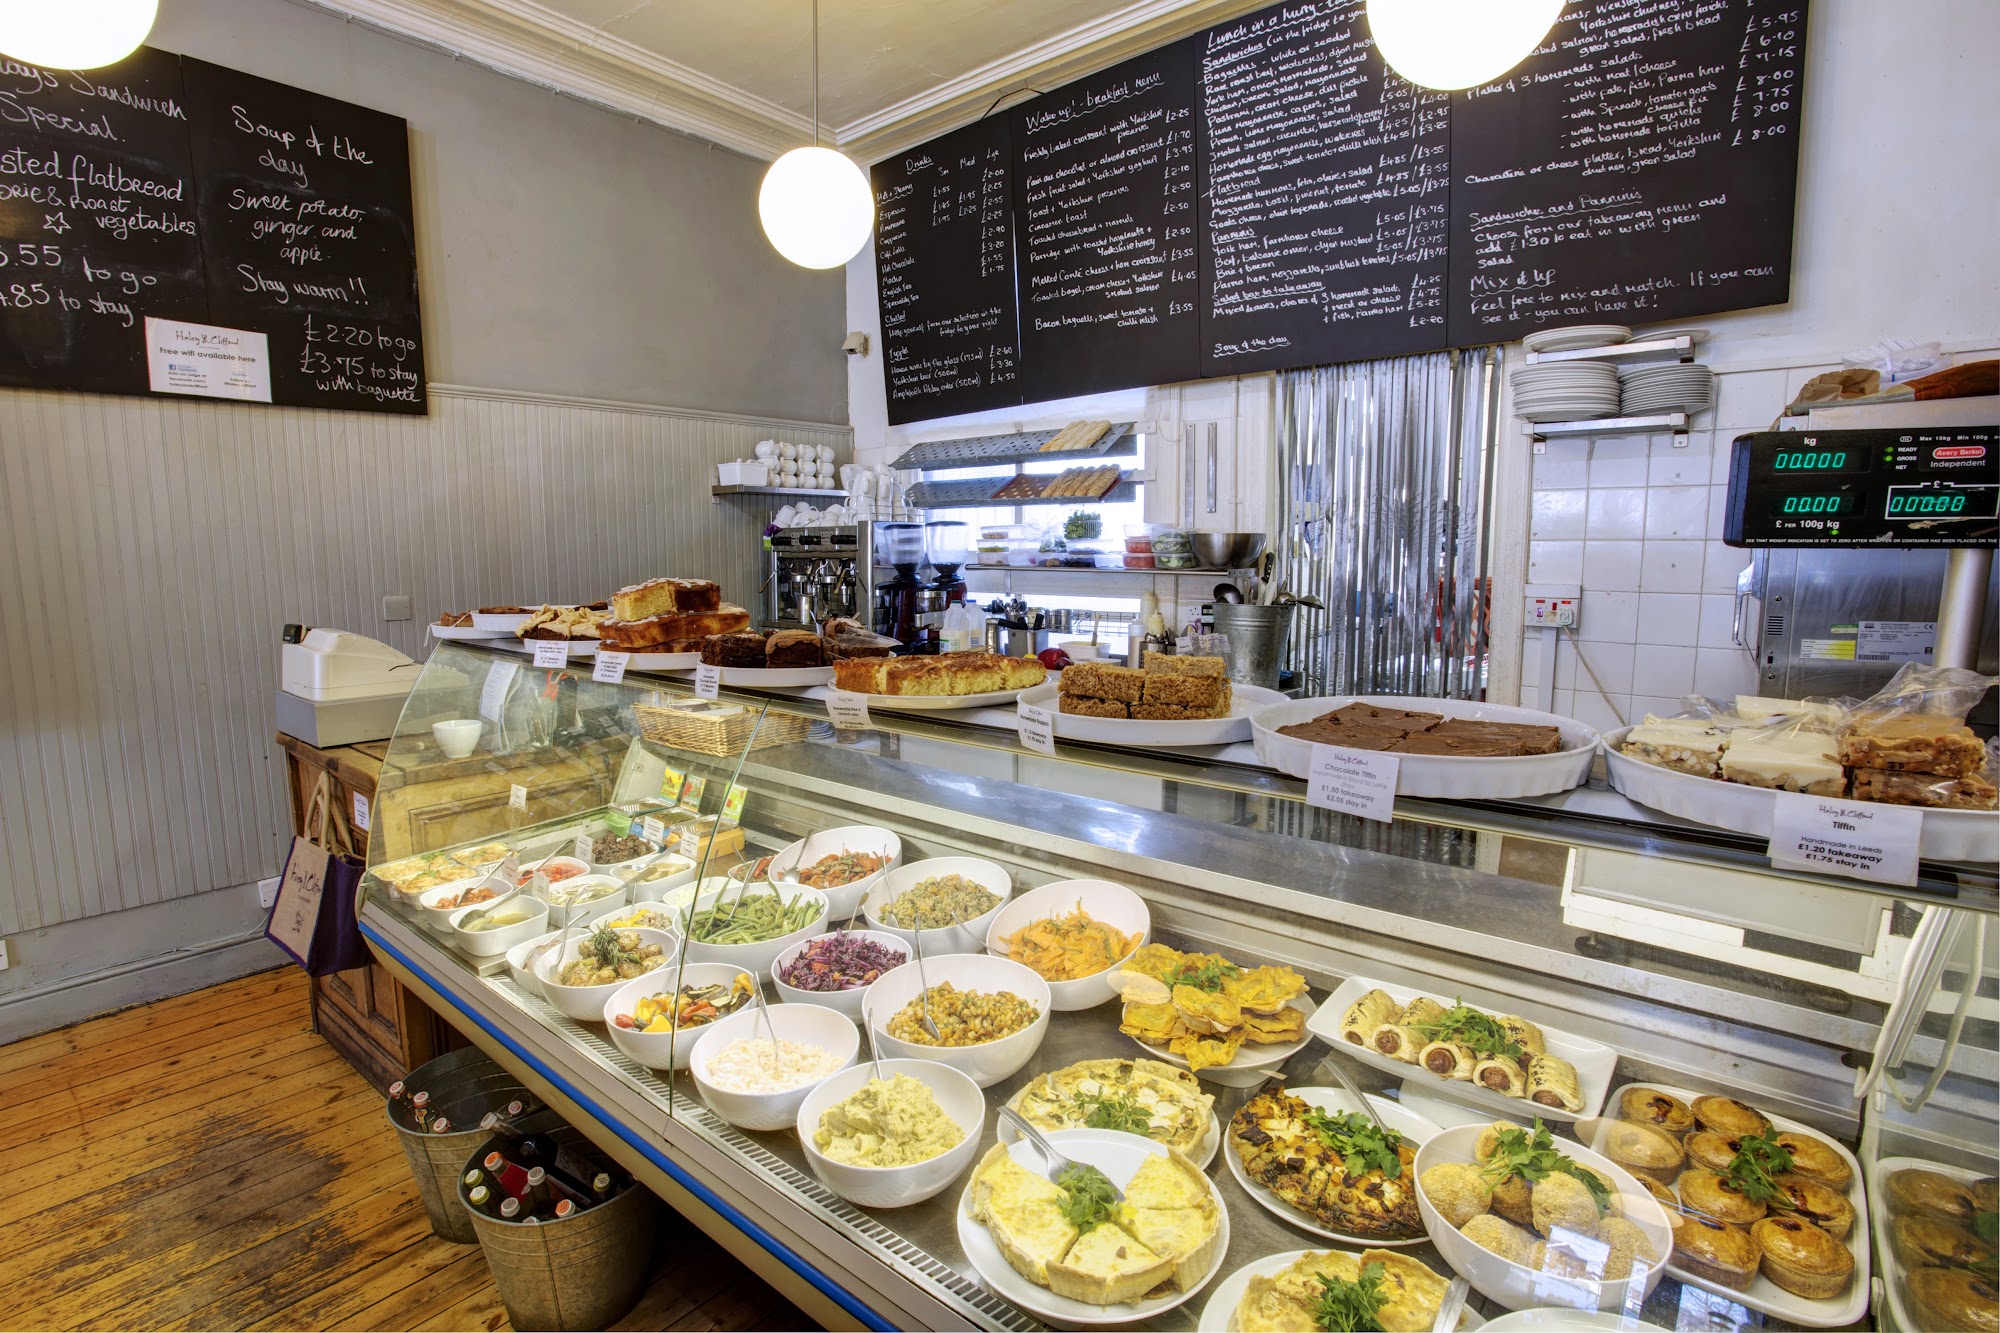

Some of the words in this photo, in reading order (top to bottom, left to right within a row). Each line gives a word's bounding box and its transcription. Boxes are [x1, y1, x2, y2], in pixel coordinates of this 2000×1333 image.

[1208, 24, 1247, 48] Lunch
[1252, 18, 1265, 32] in
[1269, 16, 1278, 26] a
[1282, 4, 1317, 22] hurry
[1202, 42, 1263, 69] Sandwiches
[1285, 29, 1300, 41] the
[1302, 18, 1330, 37] fridge
[1506, 79, 1516, 93] of
[1521, 75, 1531, 87] 3
[1535, 62, 1594, 83] homemade
[1599, 50, 1642, 68] salads
[70, 69, 187, 121] Sandwich
[1026, 111, 1057, 130] Wake
[1087, 82, 1129, 106] breakfast
[1166, 108, 1189, 124] £2.25
[231, 105, 297, 150] Soup
[306, 125, 325, 156] of
[333, 136, 374, 165] the
[1166, 130, 1191, 146] £1.70
[906, 155, 933, 172] Drinks
[1166, 147, 1193, 161] £3.95
[67, 154, 183, 202] flatbread
[259, 149, 308, 189] day
[47, 185, 66, 206] &
[228, 189, 293, 211] Sweet
[1209, 178, 1261, 198] Flatbread
[1469, 206, 1544, 227] Sandwiches
[1548, 202, 1574, 213] and
[1579, 187, 1642, 208] Panninis
[1474, 231, 1520, 242] Choose
[1524, 225, 1553, 239] from
[1557, 220, 1583, 231] our
[1588, 211, 1653, 227] takeaway
[1698, 194, 1727, 207] and
[251, 219, 315, 244] ginger
[321, 226, 358, 240] and
[1475, 241, 1503, 255] add
[1554, 233, 1565, 244] to
[1569, 230, 1593, 240] eat
[1598, 227, 1612, 236] in
[1619, 219, 1657, 234] with
[1662, 214, 1700, 233] green
[1478, 255, 1514, 269] salad
[83, 256, 111, 282] to
[121, 270, 157, 295] go
[237, 264, 290, 304] Stay
[294, 277, 368, 306] warm!!
[1470, 275, 1508, 292] Mix
[1517, 271, 1528, 286] it
[1471, 297, 1506, 315] Feel
[1511, 294, 1535, 310] free
[1538, 292, 1554, 304] to
[1561, 286, 1587, 301] mix
[1590, 284, 1622, 297] and
[1690, 271, 1704, 287] If
[1710, 273, 1740, 286] you
[1744, 267, 1775, 277] can
[59, 290, 81, 312] to
[89, 292, 134, 328] stay
[1482, 315, 1508, 325] see
[1509, 311, 1521, 320] it
[1534, 308, 1560, 323] you
[1564, 306, 1590, 316] can
[1594, 301, 1628, 312] have
[160, 347, 179, 355] Free
[181, 349, 196, 357] wifi
[198, 352, 236, 361] available
[239, 354, 257, 363] here
[378, 326, 393, 350] to
[394, 338, 416, 361] go
[300, 343, 365, 374] £3.75
[371, 362, 387, 379] to
[390, 364, 418, 391] stay
[316, 375, 355, 392] with
[357, 380, 421, 403] baguette
[1803, 436, 1817, 449] kg
[1776, 519, 1782, 528] £
[1800, 518, 1824, 529] 100g
[1827, 518, 1839, 530] kg
[1325, 764, 1360, 776] Chocolate
[1362, 771, 1377, 779] Tiffin
[1322, 785, 1339, 793] £1.50
[1341, 789, 1374, 802] takeaway
[1327, 795, 1344, 803] £2.05
[1346, 799, 1359, 808] stay
[1833, 821, 1855, 831] Tiffin
[1798, 843, 1825, 853] £1.20
[1828, 850, 1882, 863] takeaway
[1801, 836, 1847, 848] Handmade
[1858, 846, 1883, 854] Leeds
[1806, 854, 1833, 862] £1.75
[1835, 858, 1857, 868] stay
